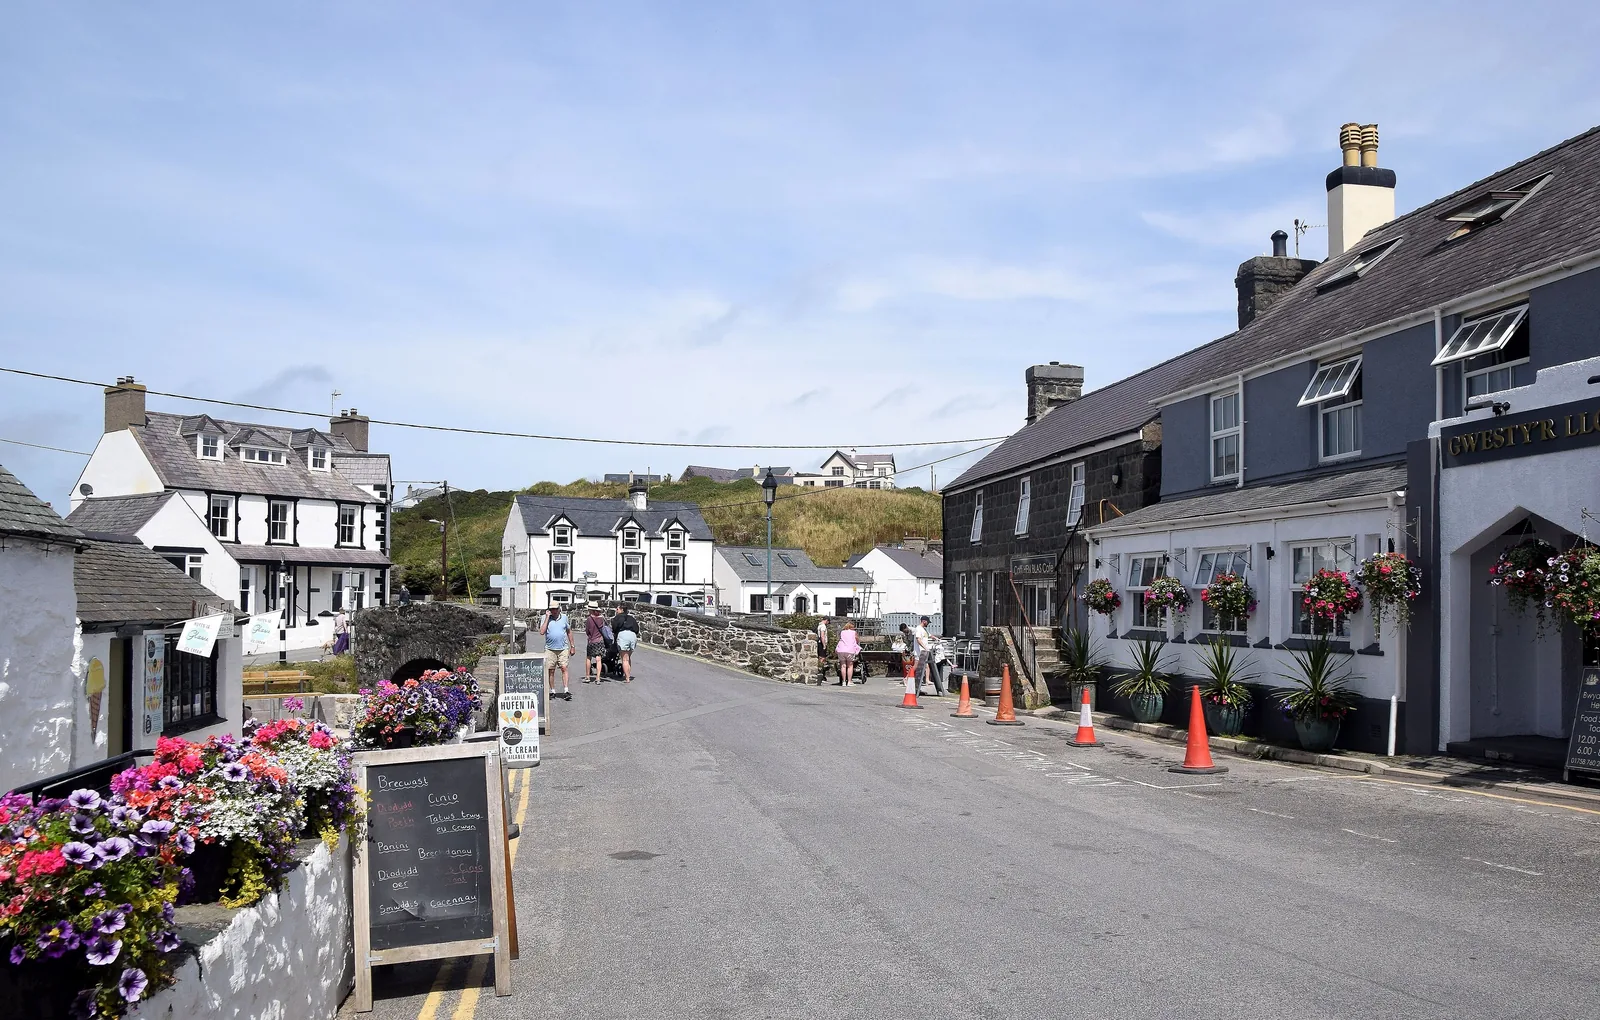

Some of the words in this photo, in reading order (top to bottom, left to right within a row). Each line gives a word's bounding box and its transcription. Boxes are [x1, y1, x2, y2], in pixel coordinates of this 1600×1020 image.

[1448, 418, 1556, 456] GWESTY'R
[500, 701, 524, 710] HUFEN
[1580, 714, 1598, 722] Food
[1577, 735, 1596, 744] 12.00
[515, 746, 538, 754] CREAM
[1577, 746, 1593, 755] 6.00
[378, 774, 428, 788] Brecwast
[428, 793, 458, 804] Cinio
[377, 840, 409, 852] Panini
[418, 847, 472, 860] Brecdanau
[378, 865, 418, 881] Diodydd
[380, 900, 418, 913] Smwddis
[430, 894, 476, 908] Cacennau
